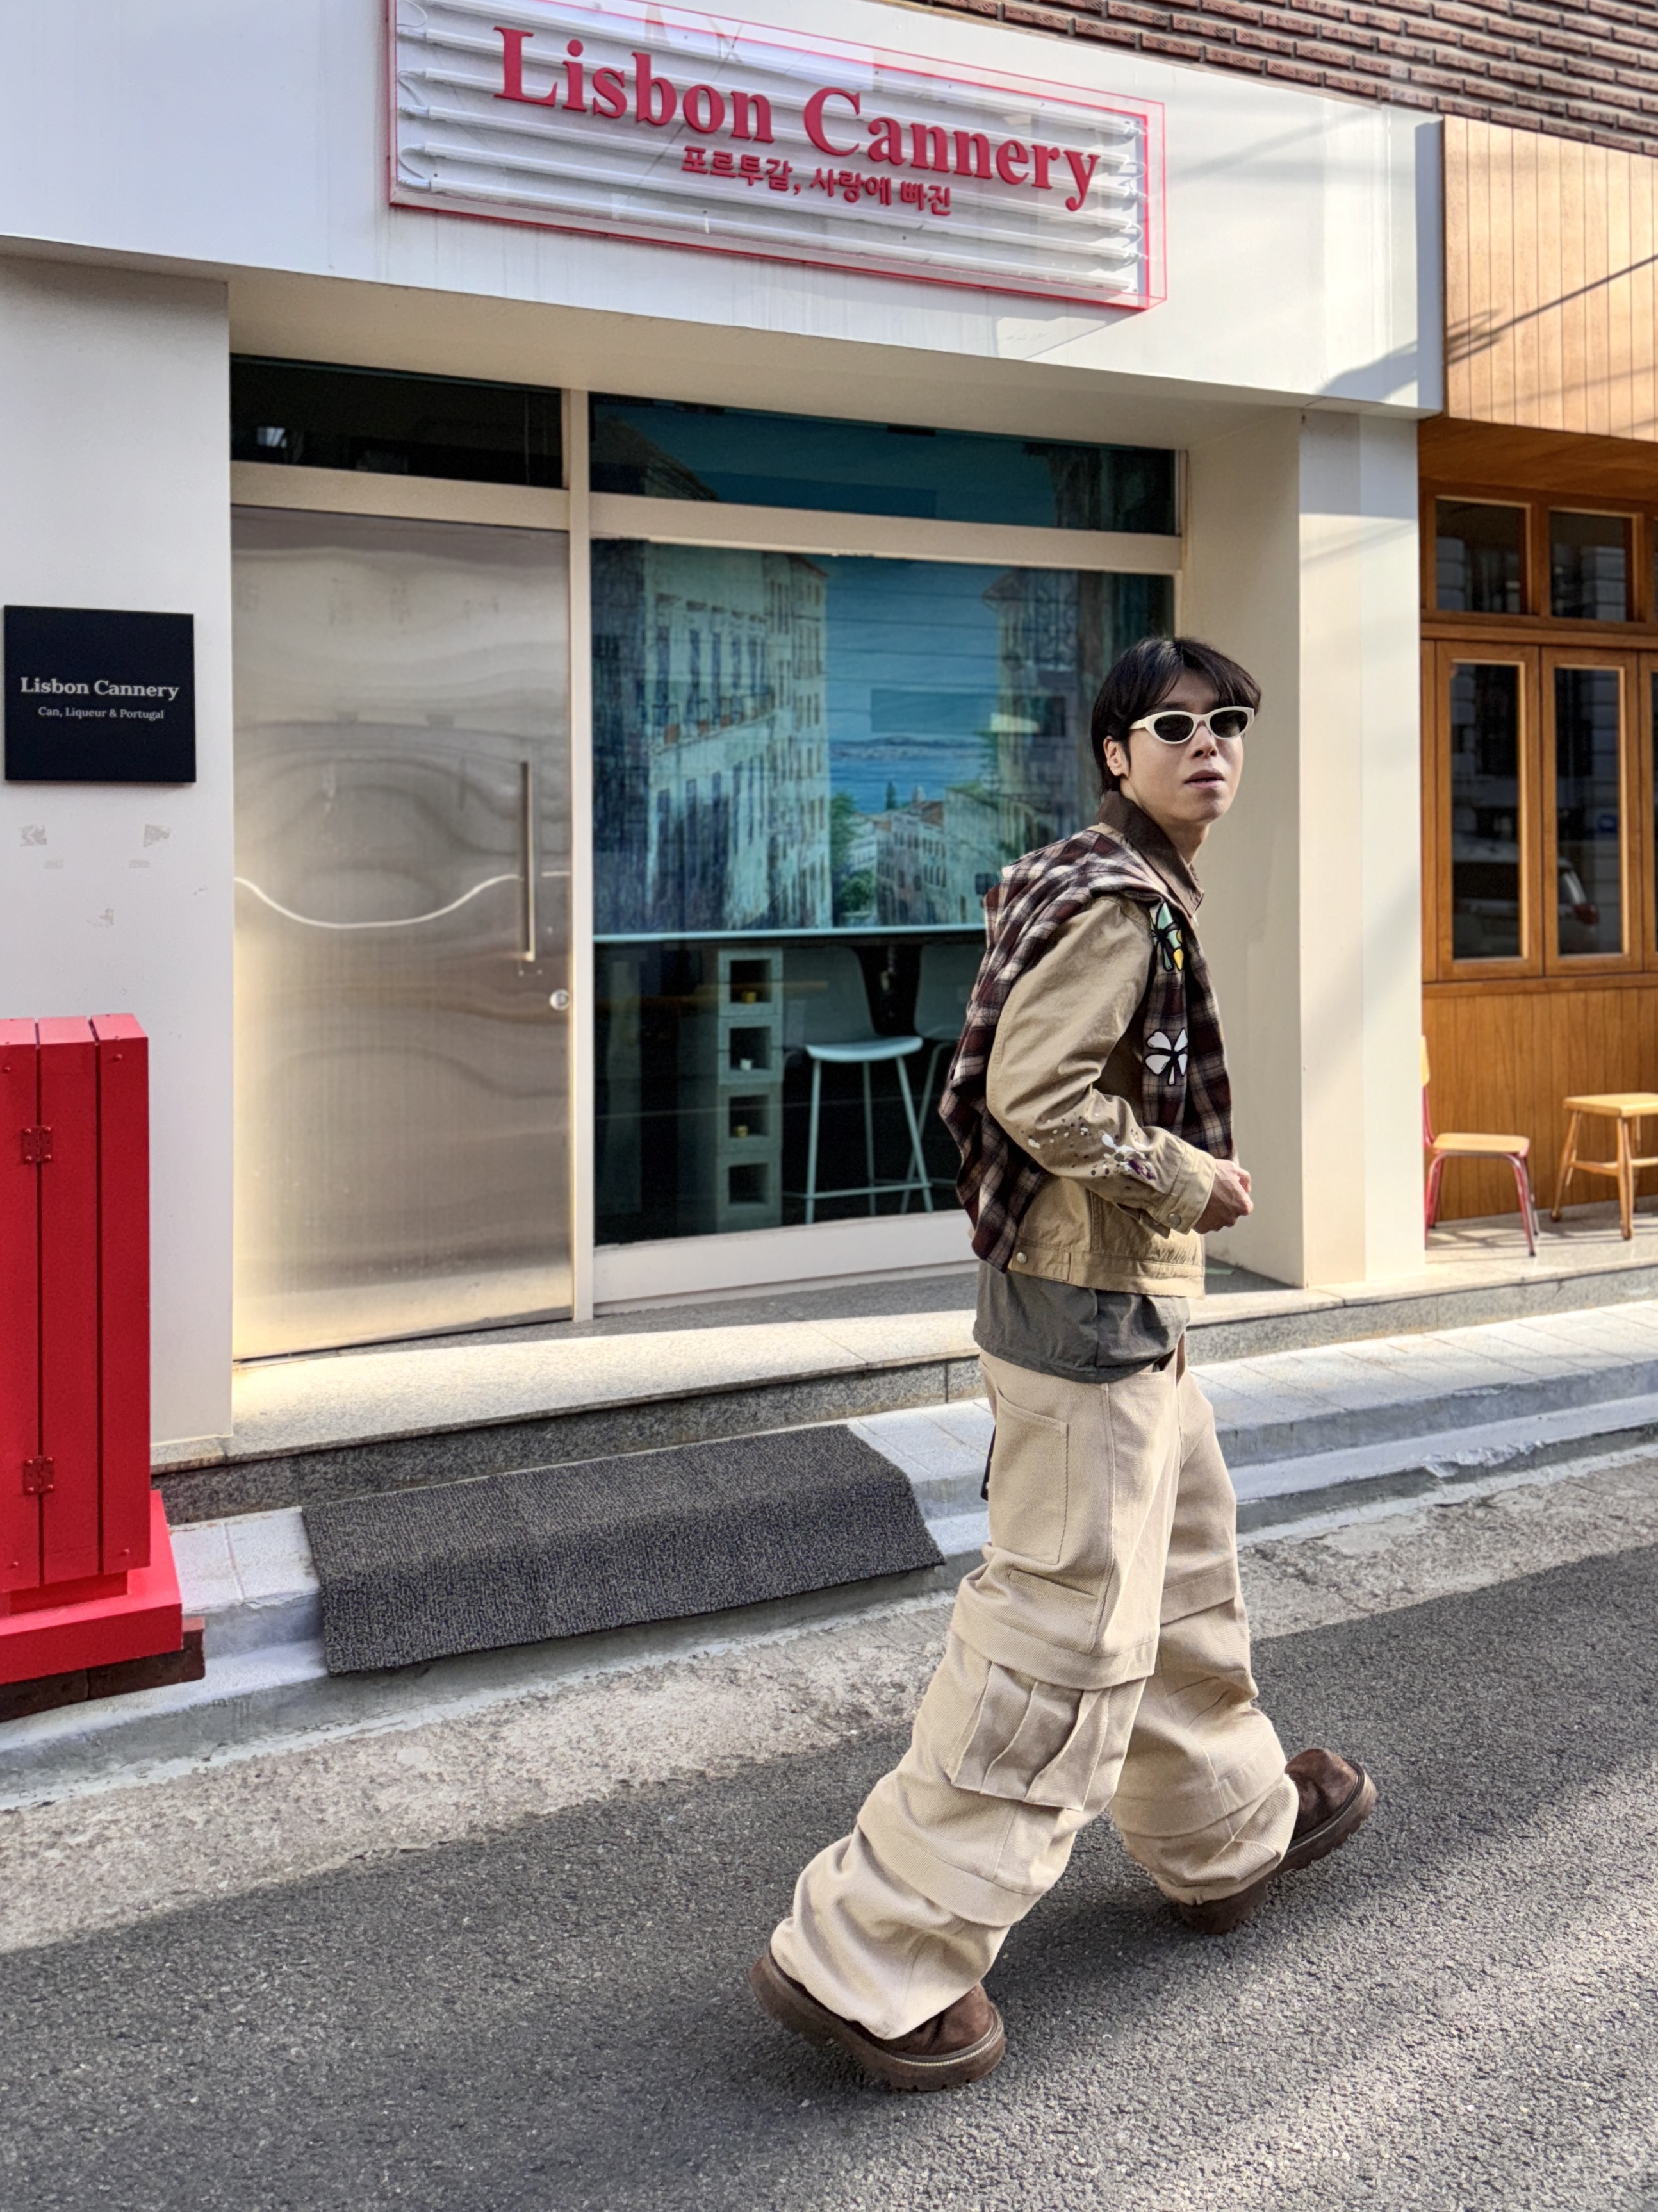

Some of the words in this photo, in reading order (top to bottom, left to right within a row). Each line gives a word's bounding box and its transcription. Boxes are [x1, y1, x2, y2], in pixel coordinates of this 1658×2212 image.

[495, 26, 774, 144] Lisbon
[803, 87, 1099, 212] Cannery
[682, 145, 801, 194] 포르투갈,
[810, 167, 892, 206] 사랑에
[899, 181, 951, 216] 빠진
[20, 677, 90, 695] Lisbon
[94, 679, 180, 702] Cannery
[38, 706, 63, 718] Can,
[65, 707, 107, 720] Liqueur
[109, 709, 118, 718] &
[120, 709, 164, 722] Portugal
